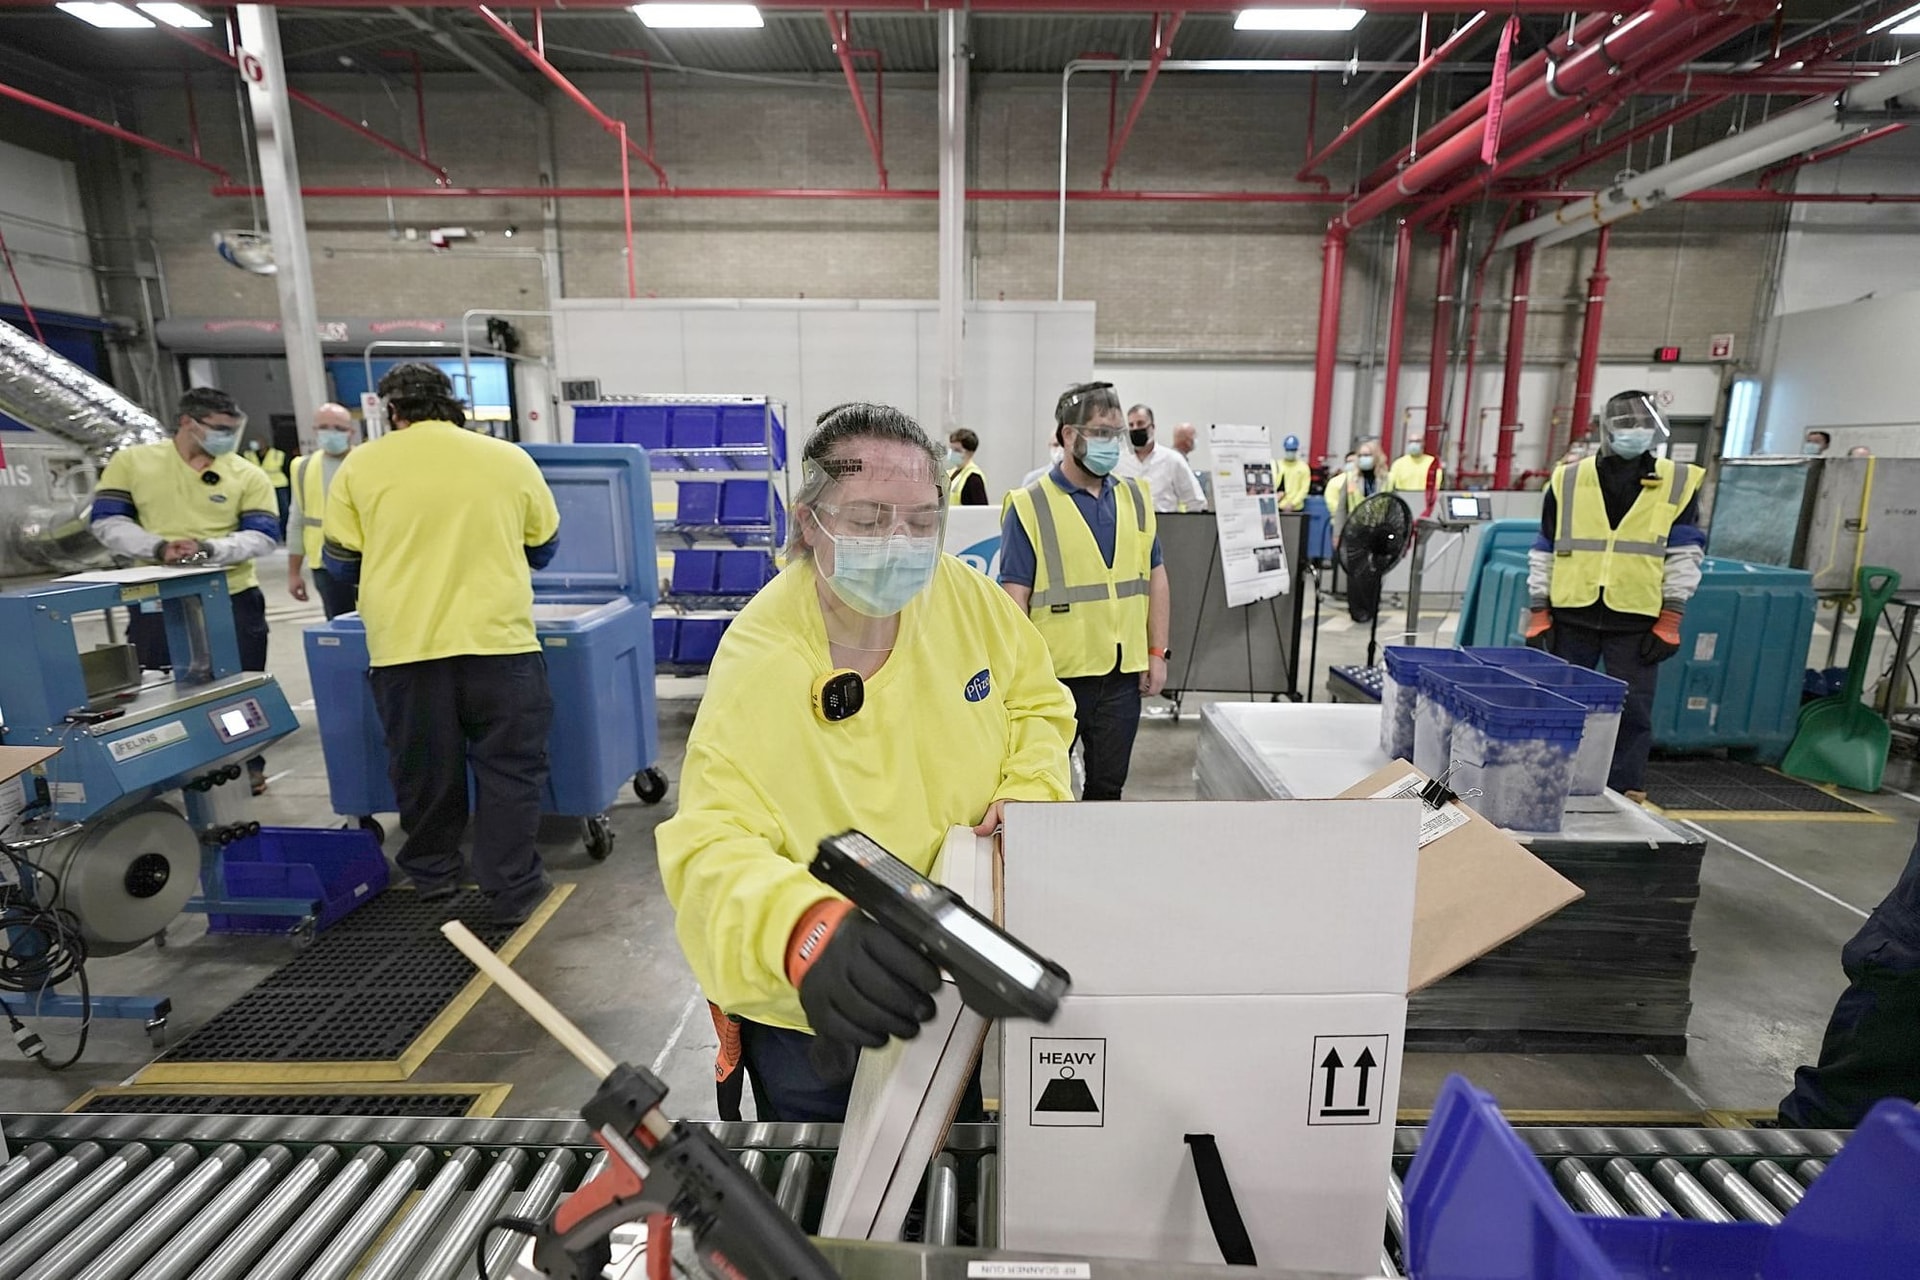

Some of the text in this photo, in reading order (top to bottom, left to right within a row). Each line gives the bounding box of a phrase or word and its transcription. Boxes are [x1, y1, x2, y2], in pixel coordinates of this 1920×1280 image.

[966, 676, 990, 701] Pfize
[117, 733, 159, 755] FELINS
[1039, 1051, 1097, 1066] HEAVY
